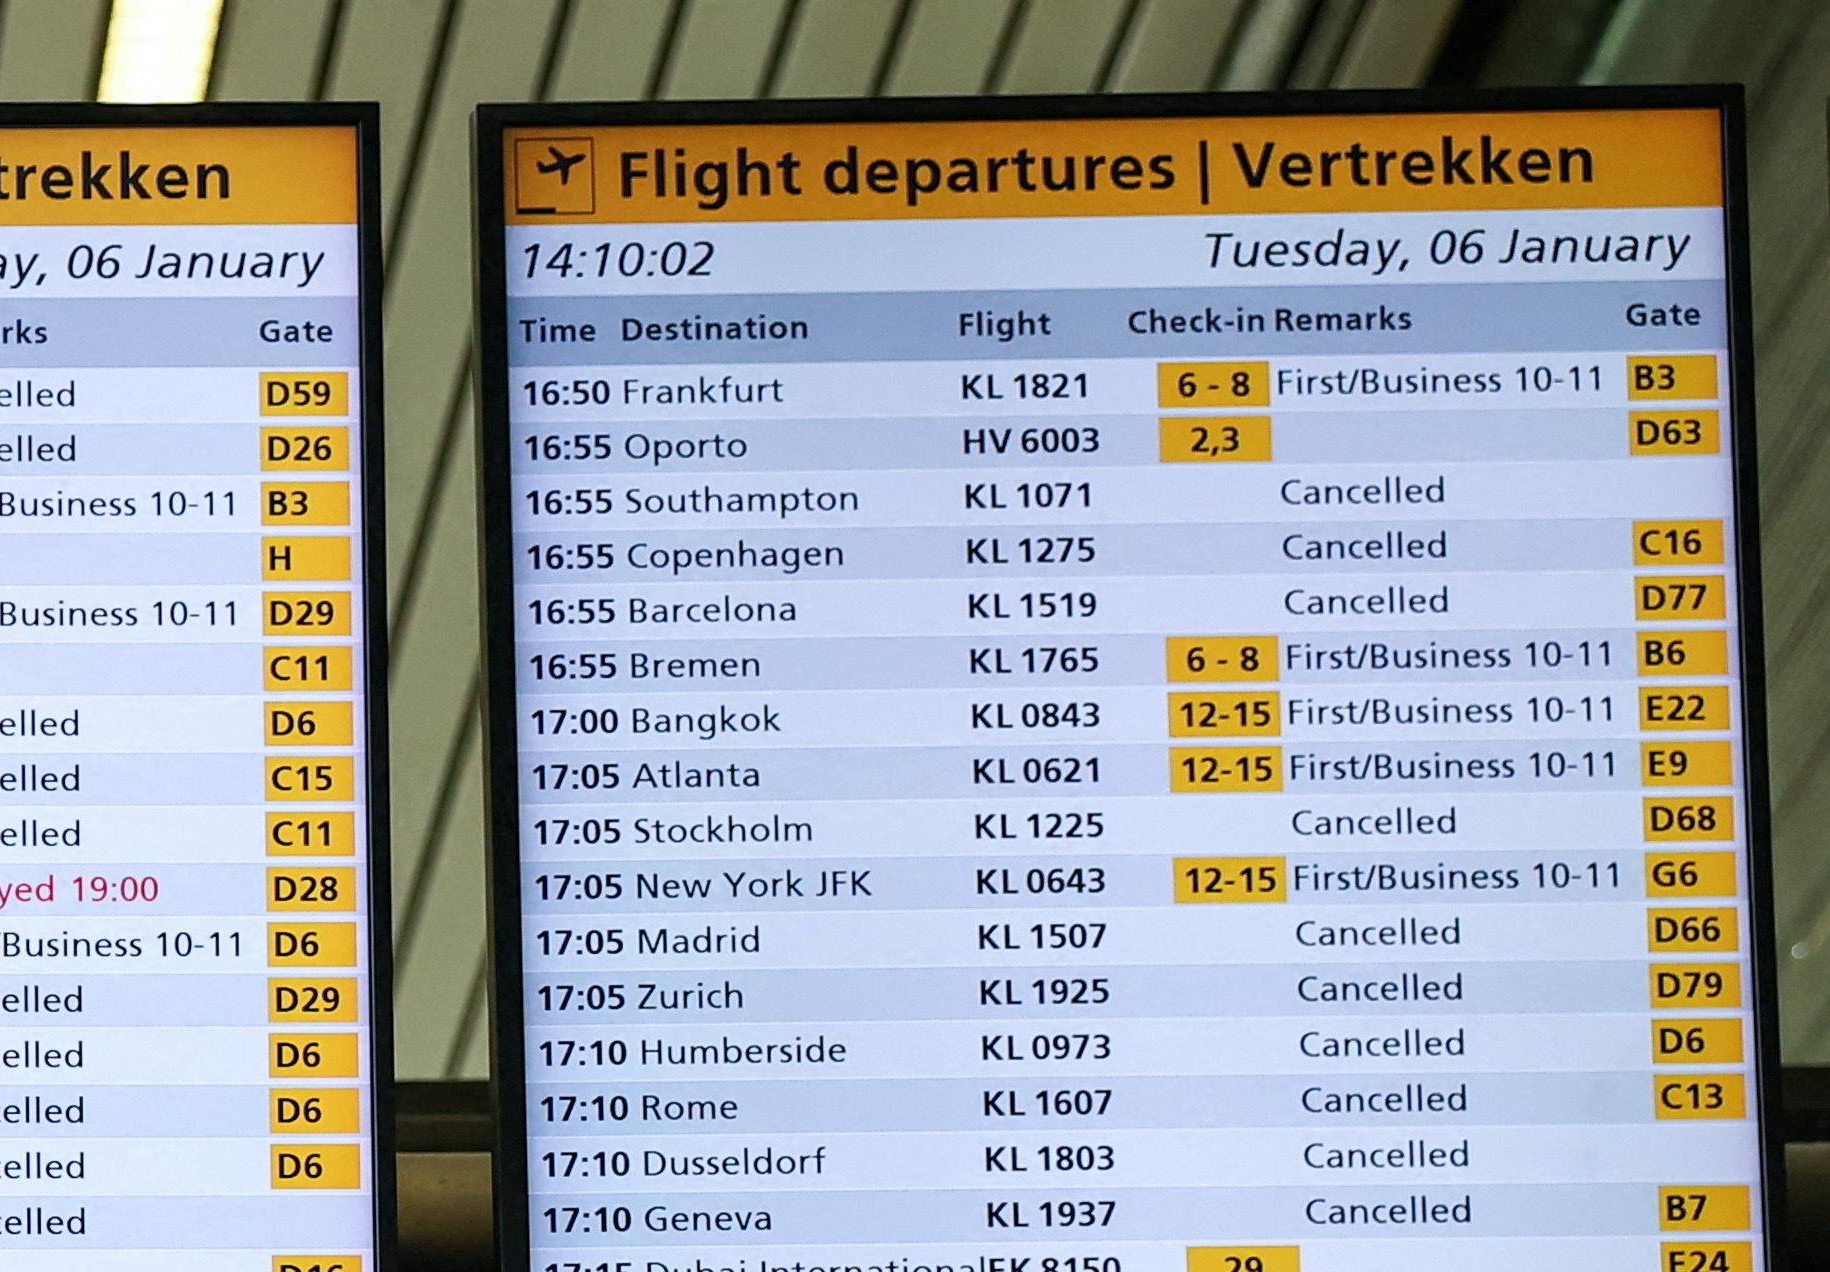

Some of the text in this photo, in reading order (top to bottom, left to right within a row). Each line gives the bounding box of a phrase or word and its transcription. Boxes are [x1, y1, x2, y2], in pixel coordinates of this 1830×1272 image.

[619, 145, 804, 212] Flight
[822, 144, 1177, 209] departures
[1230, 133, 1595, 190] Vertrekken
[65, 242, 124, 281] 06
[133, 242, 327, 290] January
[523, 239, 716, 280] 14:10:02
[1204, 226, 1692, 277] Tuesday, 06 January
[265, 379, 333, 408] D59
[523, 417, 1703, 468] 16:55 Oporto HV 6003 2,3 D63
[275, 1040, 323, 1069] D6
